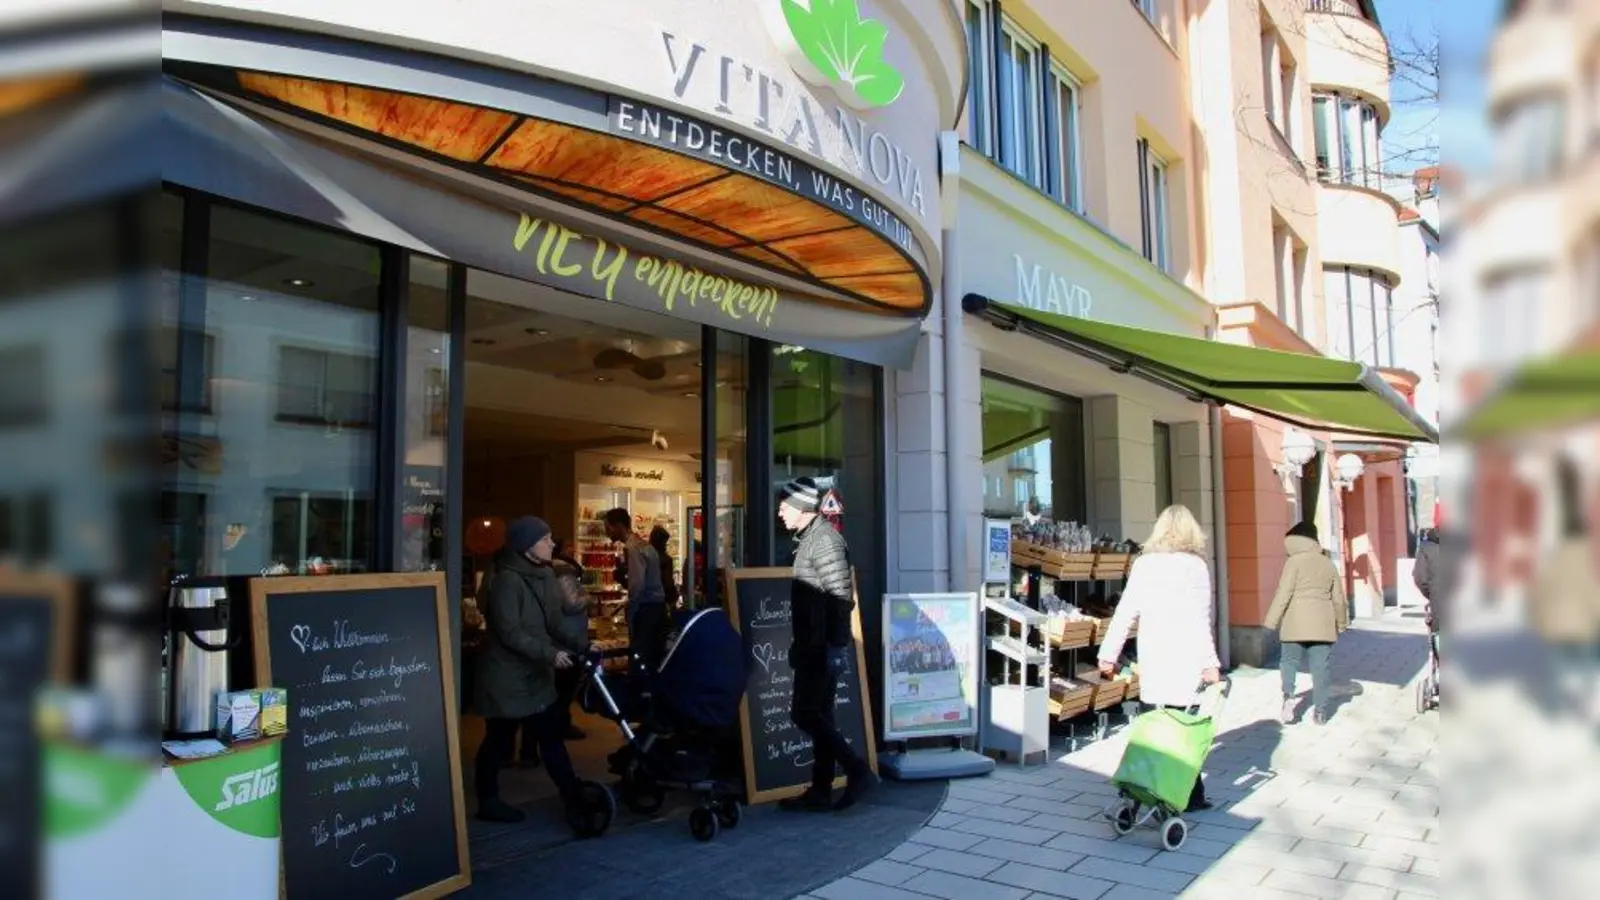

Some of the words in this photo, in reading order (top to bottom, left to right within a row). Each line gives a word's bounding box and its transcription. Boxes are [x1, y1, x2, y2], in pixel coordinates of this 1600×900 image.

[618, 102, 801, 191] ENTDECKEN,
[811, 171, 855, 211] WAS
[862, 197, 890, 232] GUT
[1012, 253, 1092, 320] MAYR
[213, 761, 279, 812] Salus
